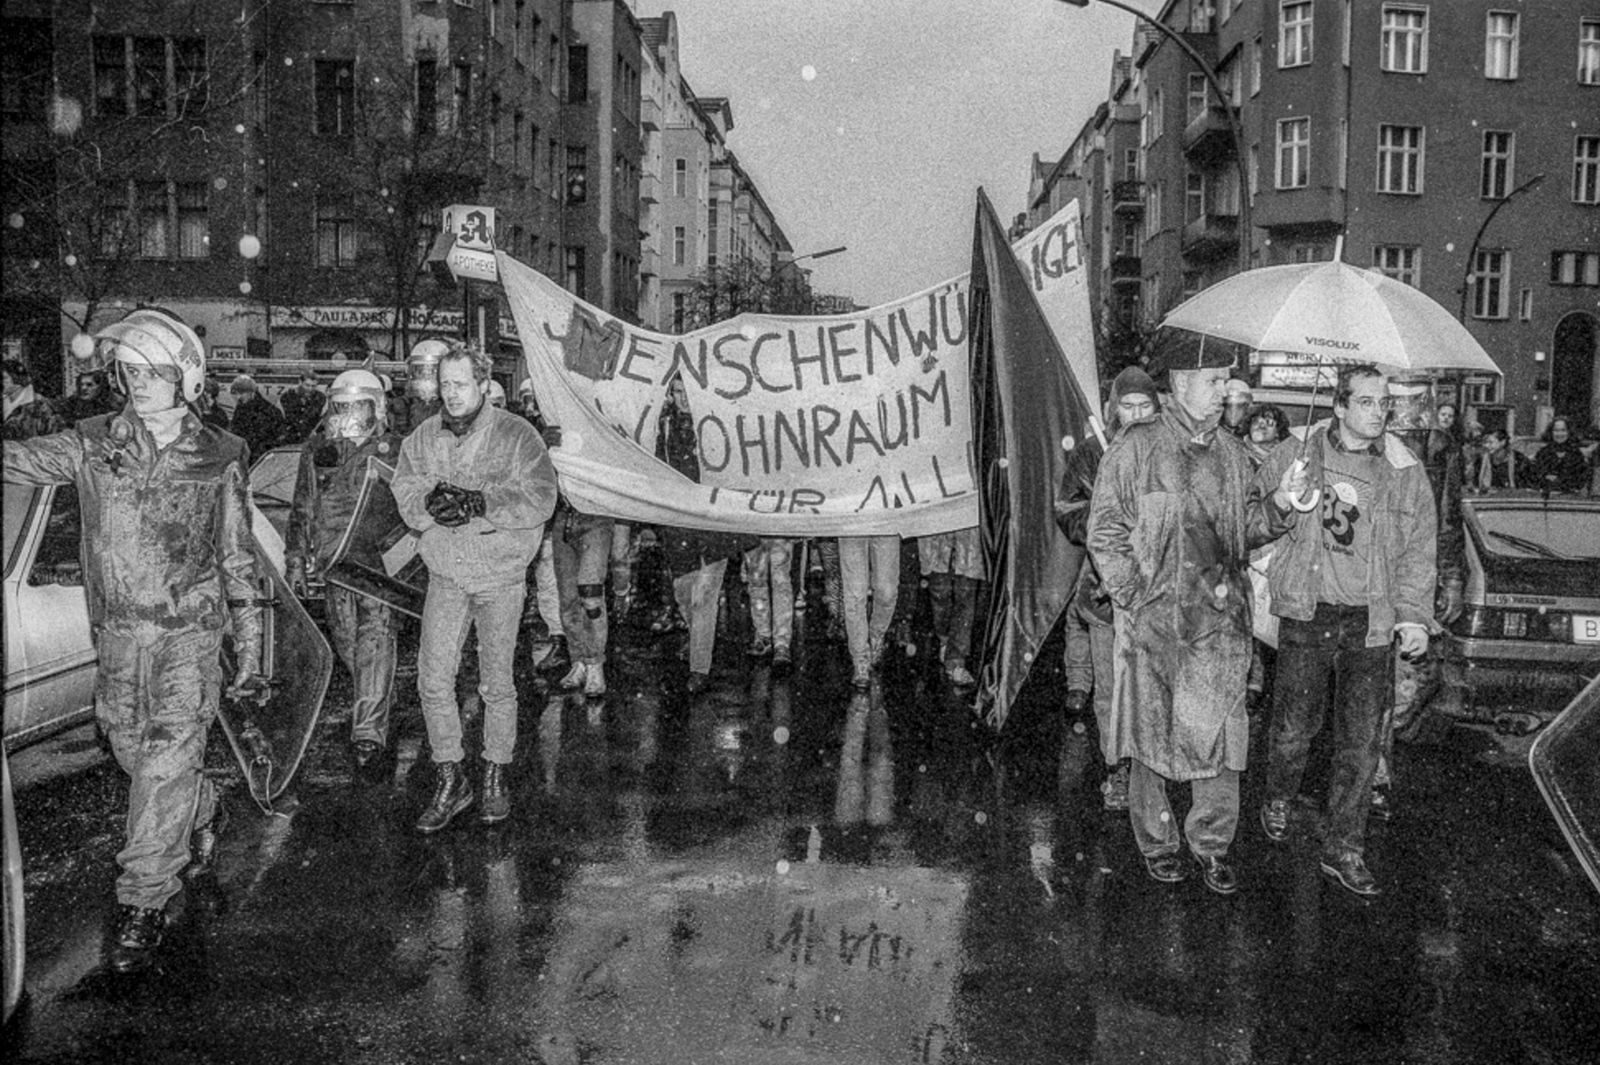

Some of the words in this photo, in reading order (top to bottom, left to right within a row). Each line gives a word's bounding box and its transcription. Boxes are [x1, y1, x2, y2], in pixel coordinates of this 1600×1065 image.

[453, 255, 495, 275] APOTHEKE
[313, 309, 388, 324] PAULANER
[1305, 336, 1360, 351] VISOLUX
[1585, 619, 1598, 638] B
